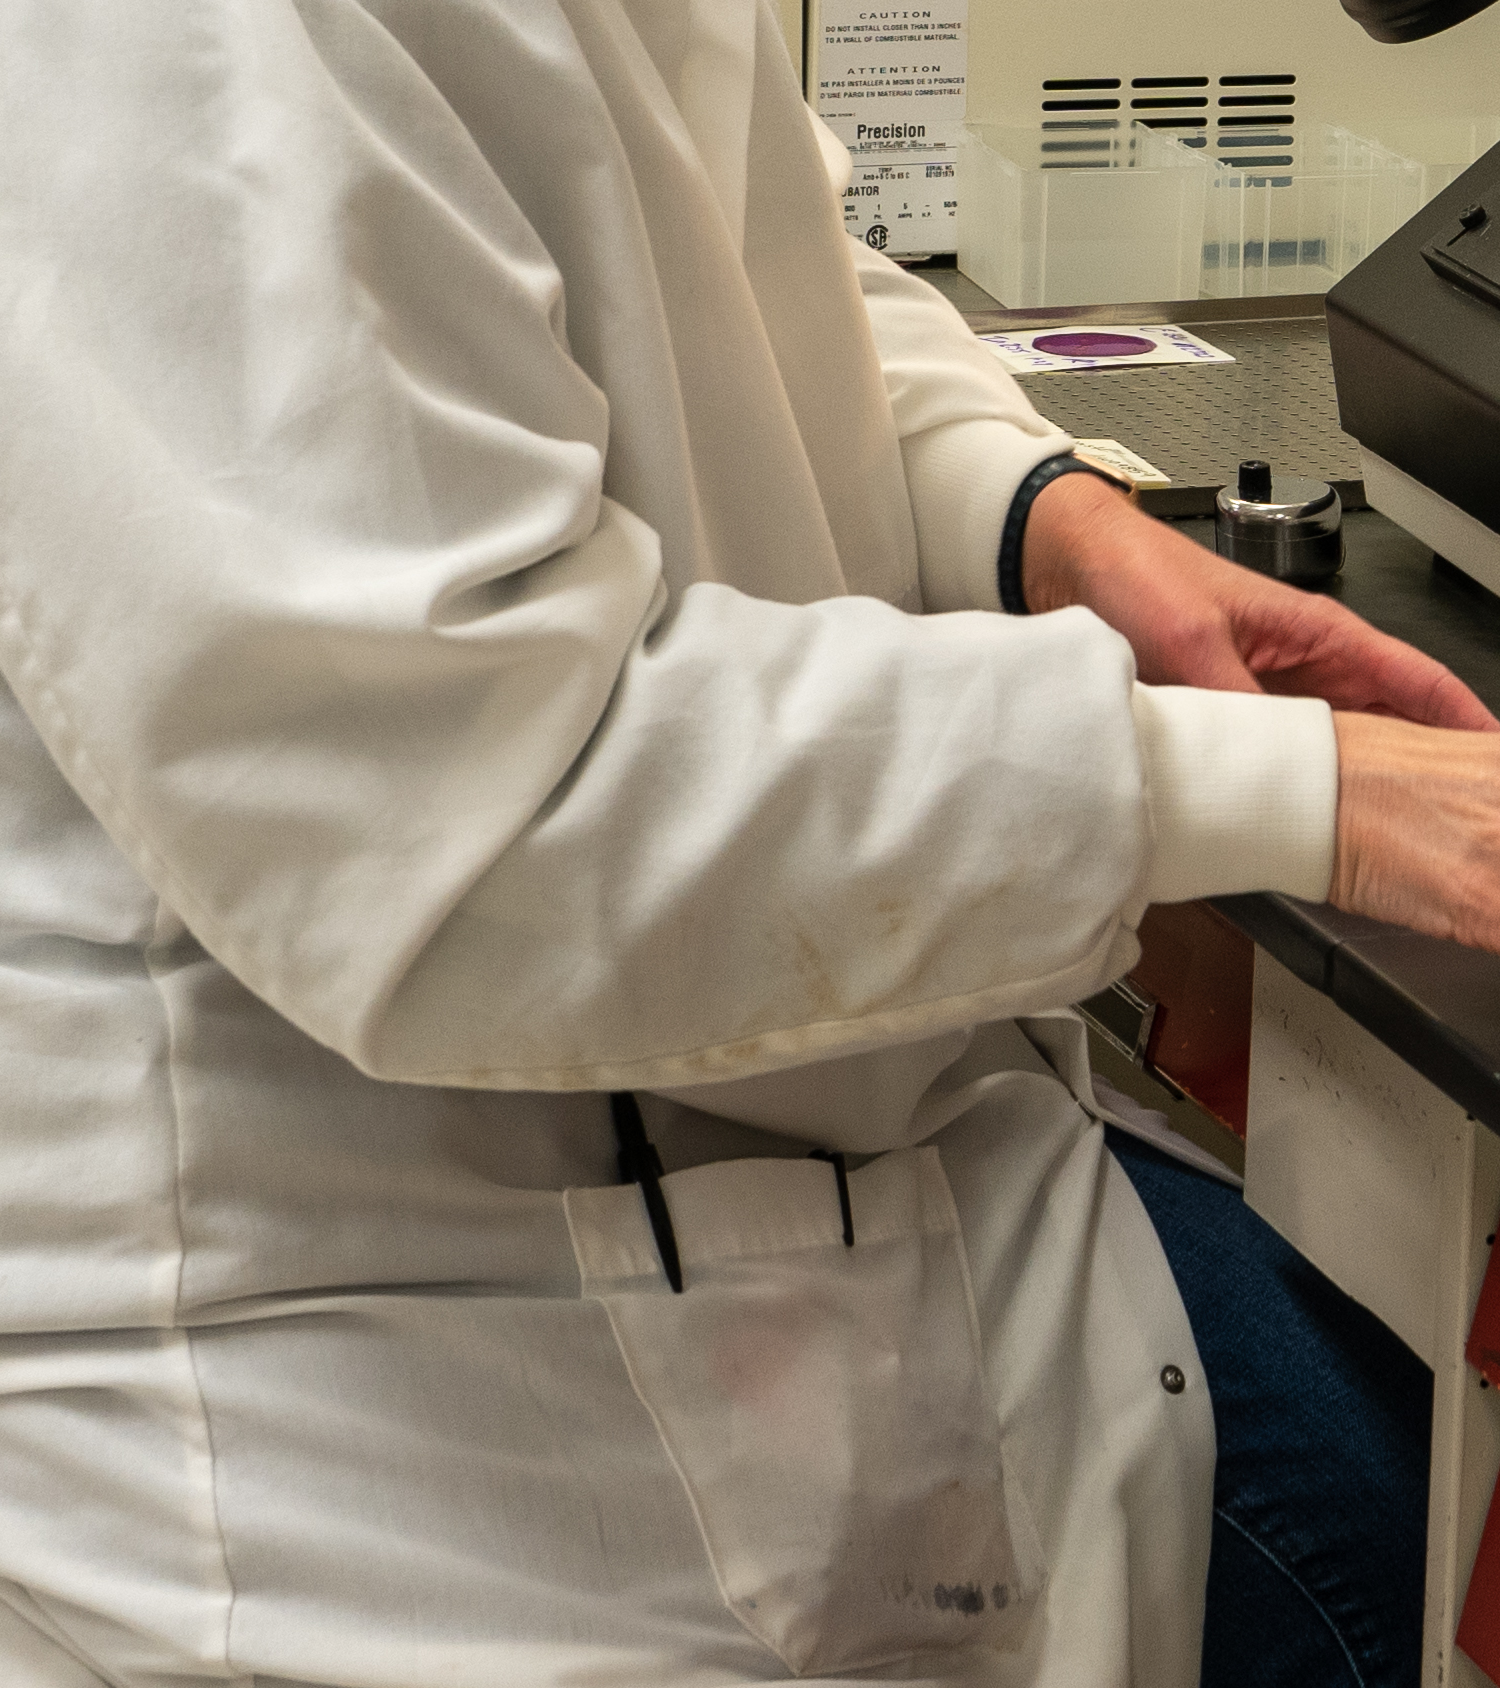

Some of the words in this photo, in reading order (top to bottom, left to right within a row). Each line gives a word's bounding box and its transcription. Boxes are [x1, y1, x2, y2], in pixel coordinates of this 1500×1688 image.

[859, 11, 931, 19] CAUTION
[847, 66, 941, 74] ATTENTION
[857, 123, 925, 139] Precision
[842, 186, 879, 197] UBATOR
